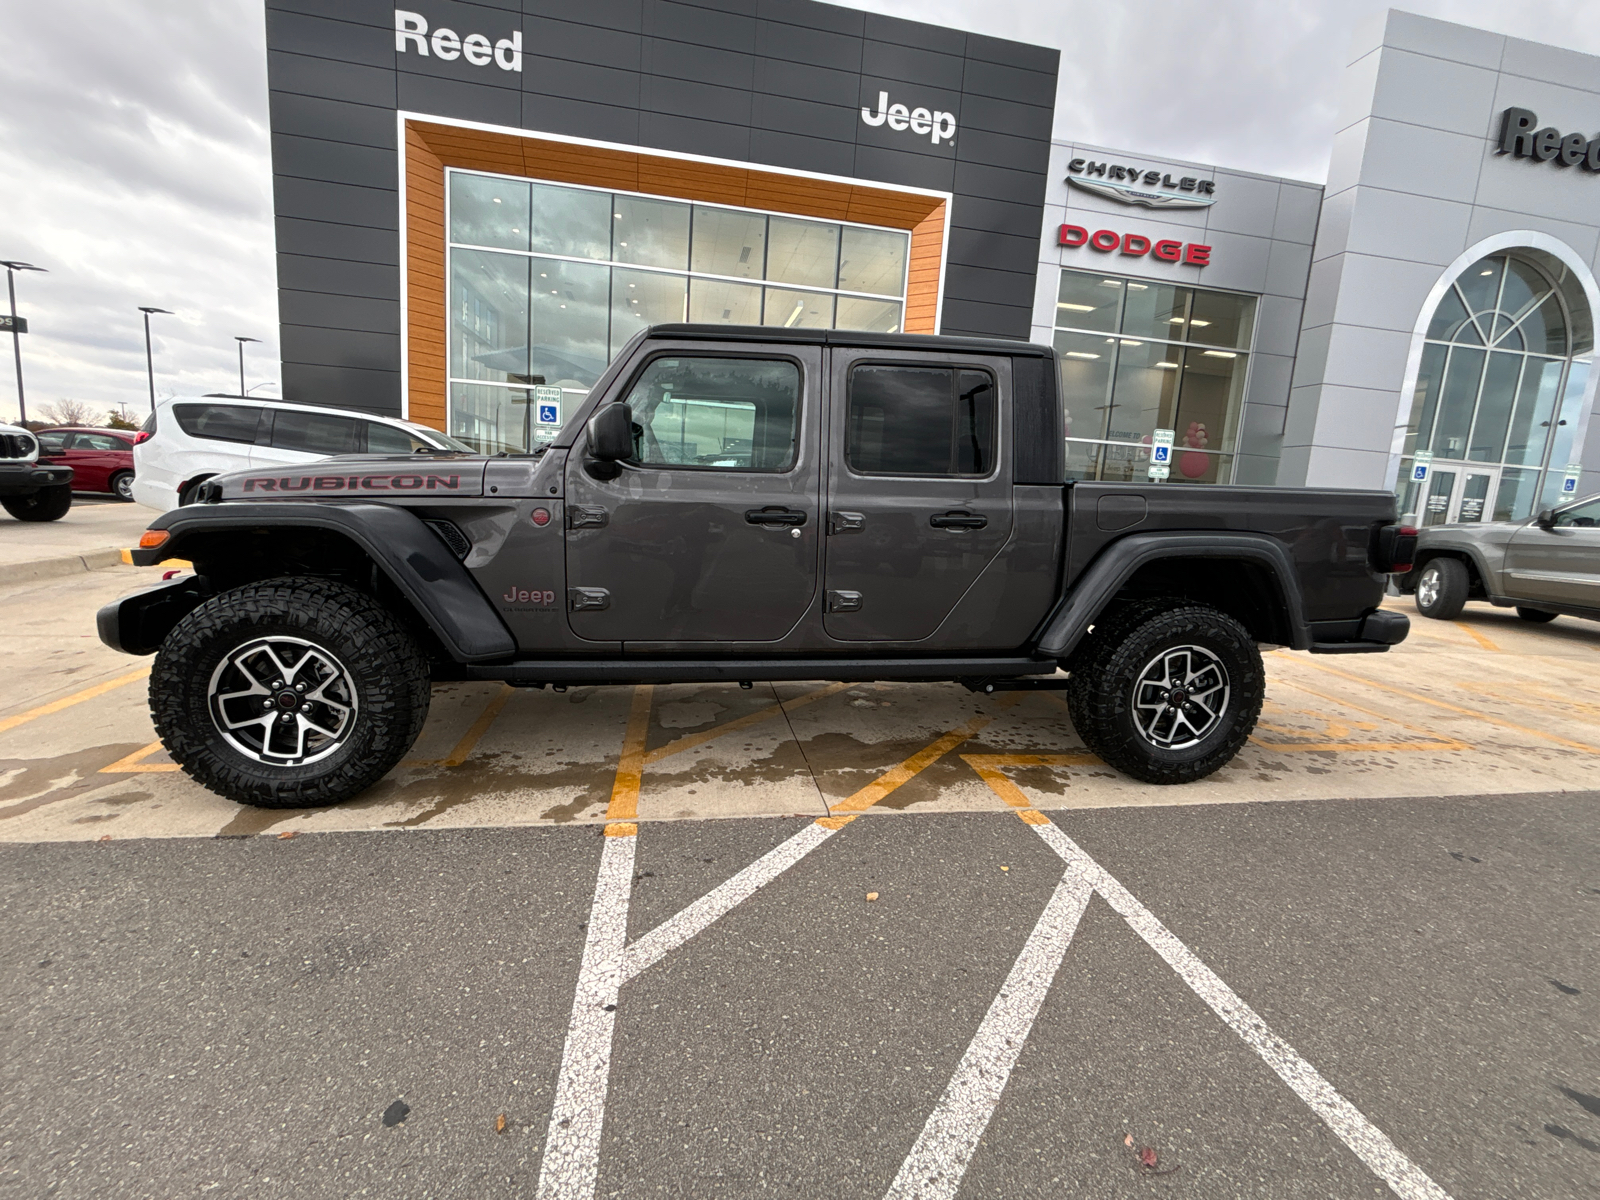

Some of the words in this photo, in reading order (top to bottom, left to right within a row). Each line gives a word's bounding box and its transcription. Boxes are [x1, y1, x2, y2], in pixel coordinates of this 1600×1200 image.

[394, 9, 523, 73] Reed
[861, 90, 957, 145] Jeep
[1067, 158, 1216, 194] CHRYSLER
[1058, 223, 1212, 267] DODGE
[537, 388, 560, 396] RESERVED
[1109, 430, 1132, 439] ELCOME
[243, 474, 461, 492] RUBICON
[503, 586, 555, 606] Jeep
